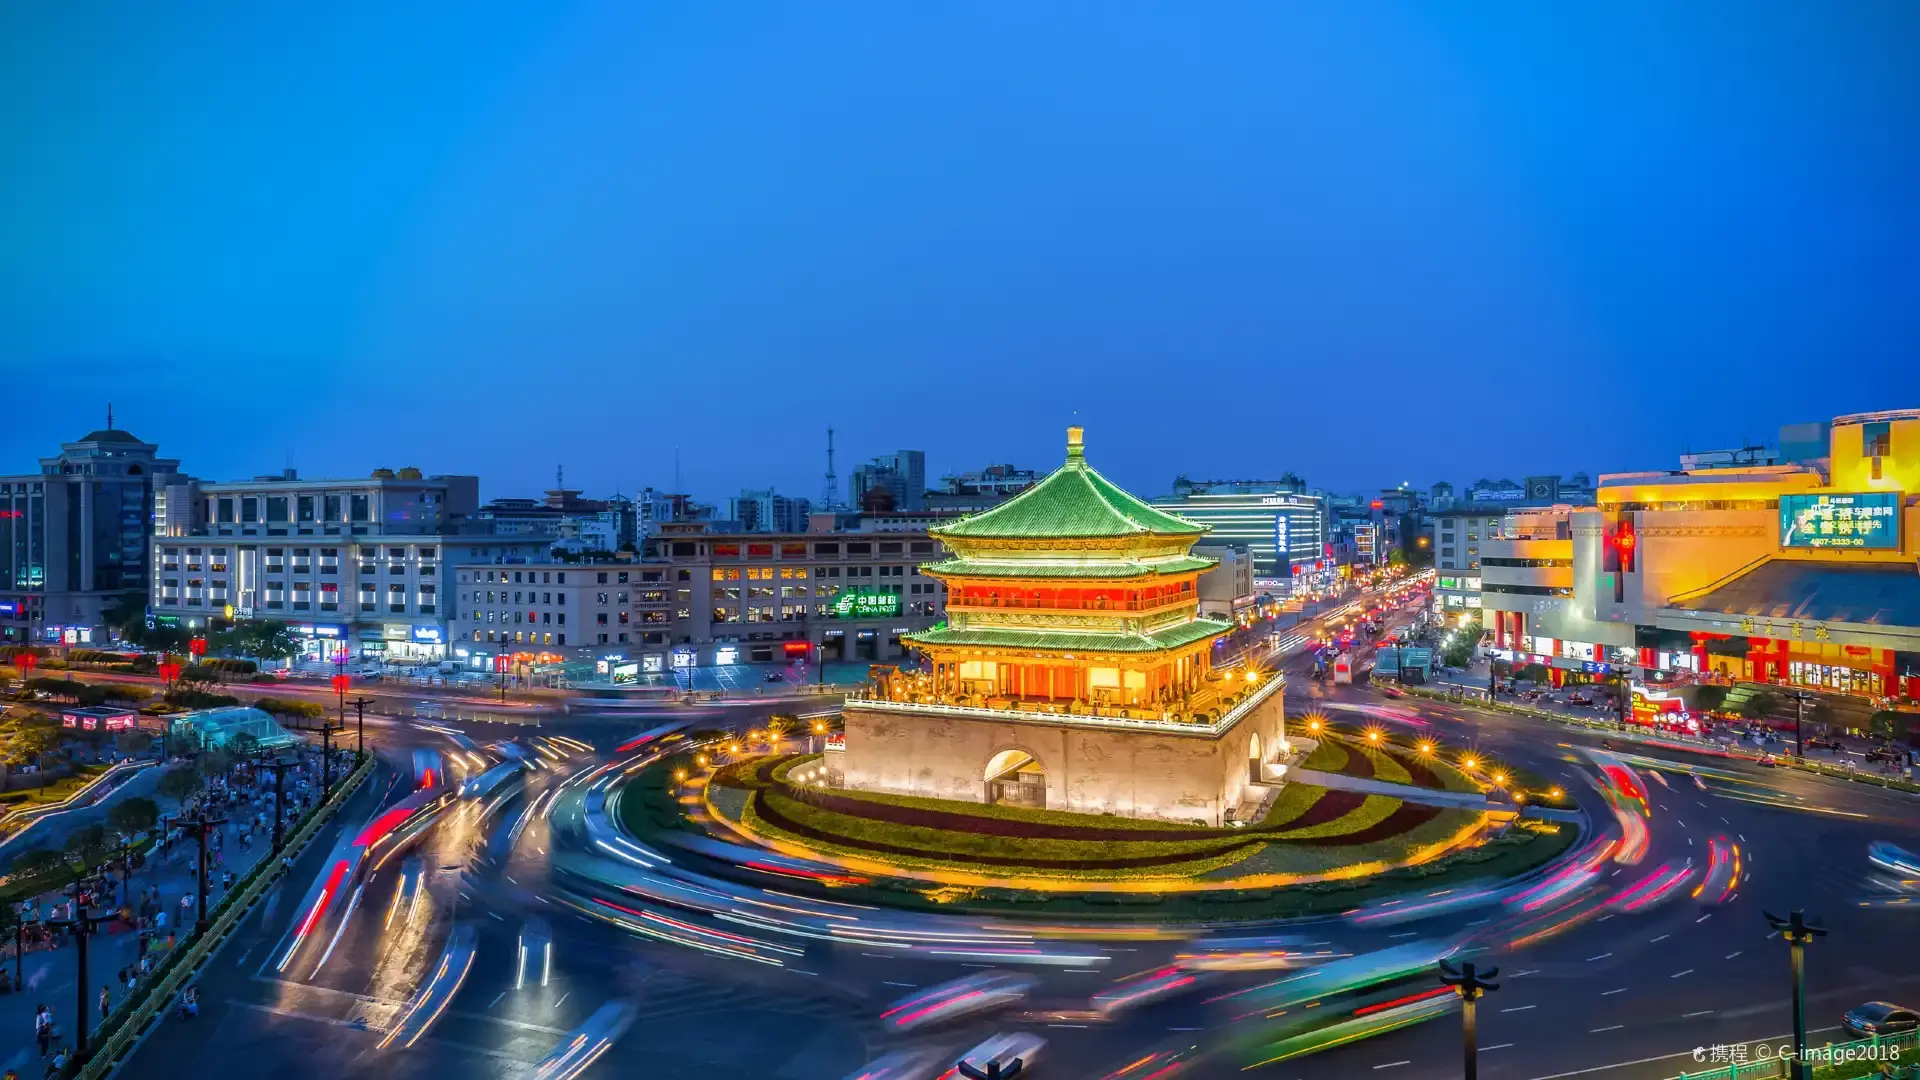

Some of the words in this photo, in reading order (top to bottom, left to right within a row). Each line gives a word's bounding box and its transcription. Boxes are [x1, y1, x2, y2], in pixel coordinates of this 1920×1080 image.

[858, 595, 897, 605] 中国邮政
[858, 605, 878, 613] CHINA
